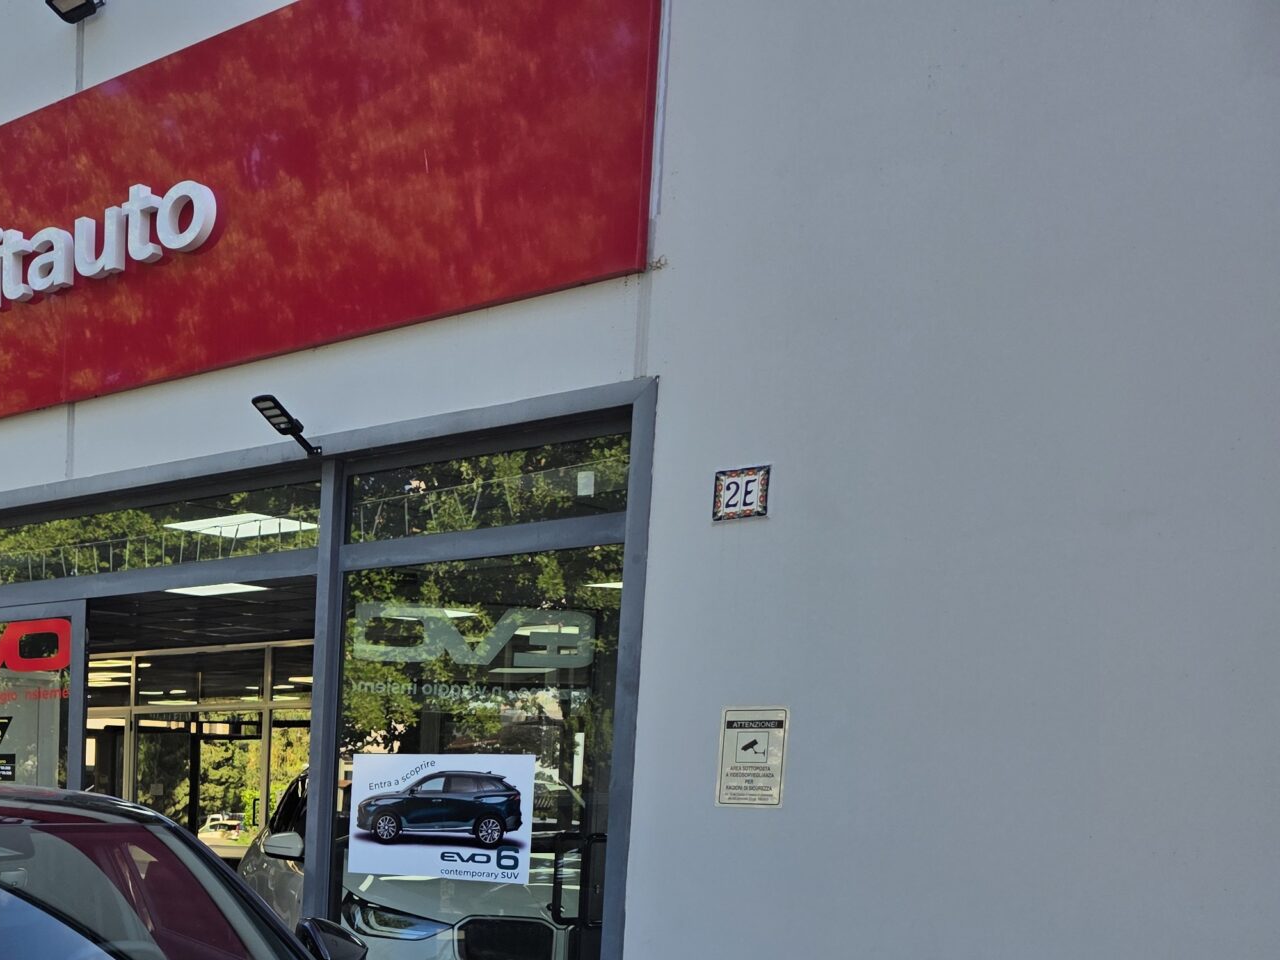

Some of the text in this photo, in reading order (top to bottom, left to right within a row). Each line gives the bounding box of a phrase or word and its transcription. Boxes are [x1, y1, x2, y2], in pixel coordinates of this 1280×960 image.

[725, 479, 757, 508] 2E
[368, 779, 392, 791] Entra
[401, 759, 436, 783] scoprire
[440, 846, 520, 871] EVO 6
[440, 867, 519, 880] contemporary SUV
